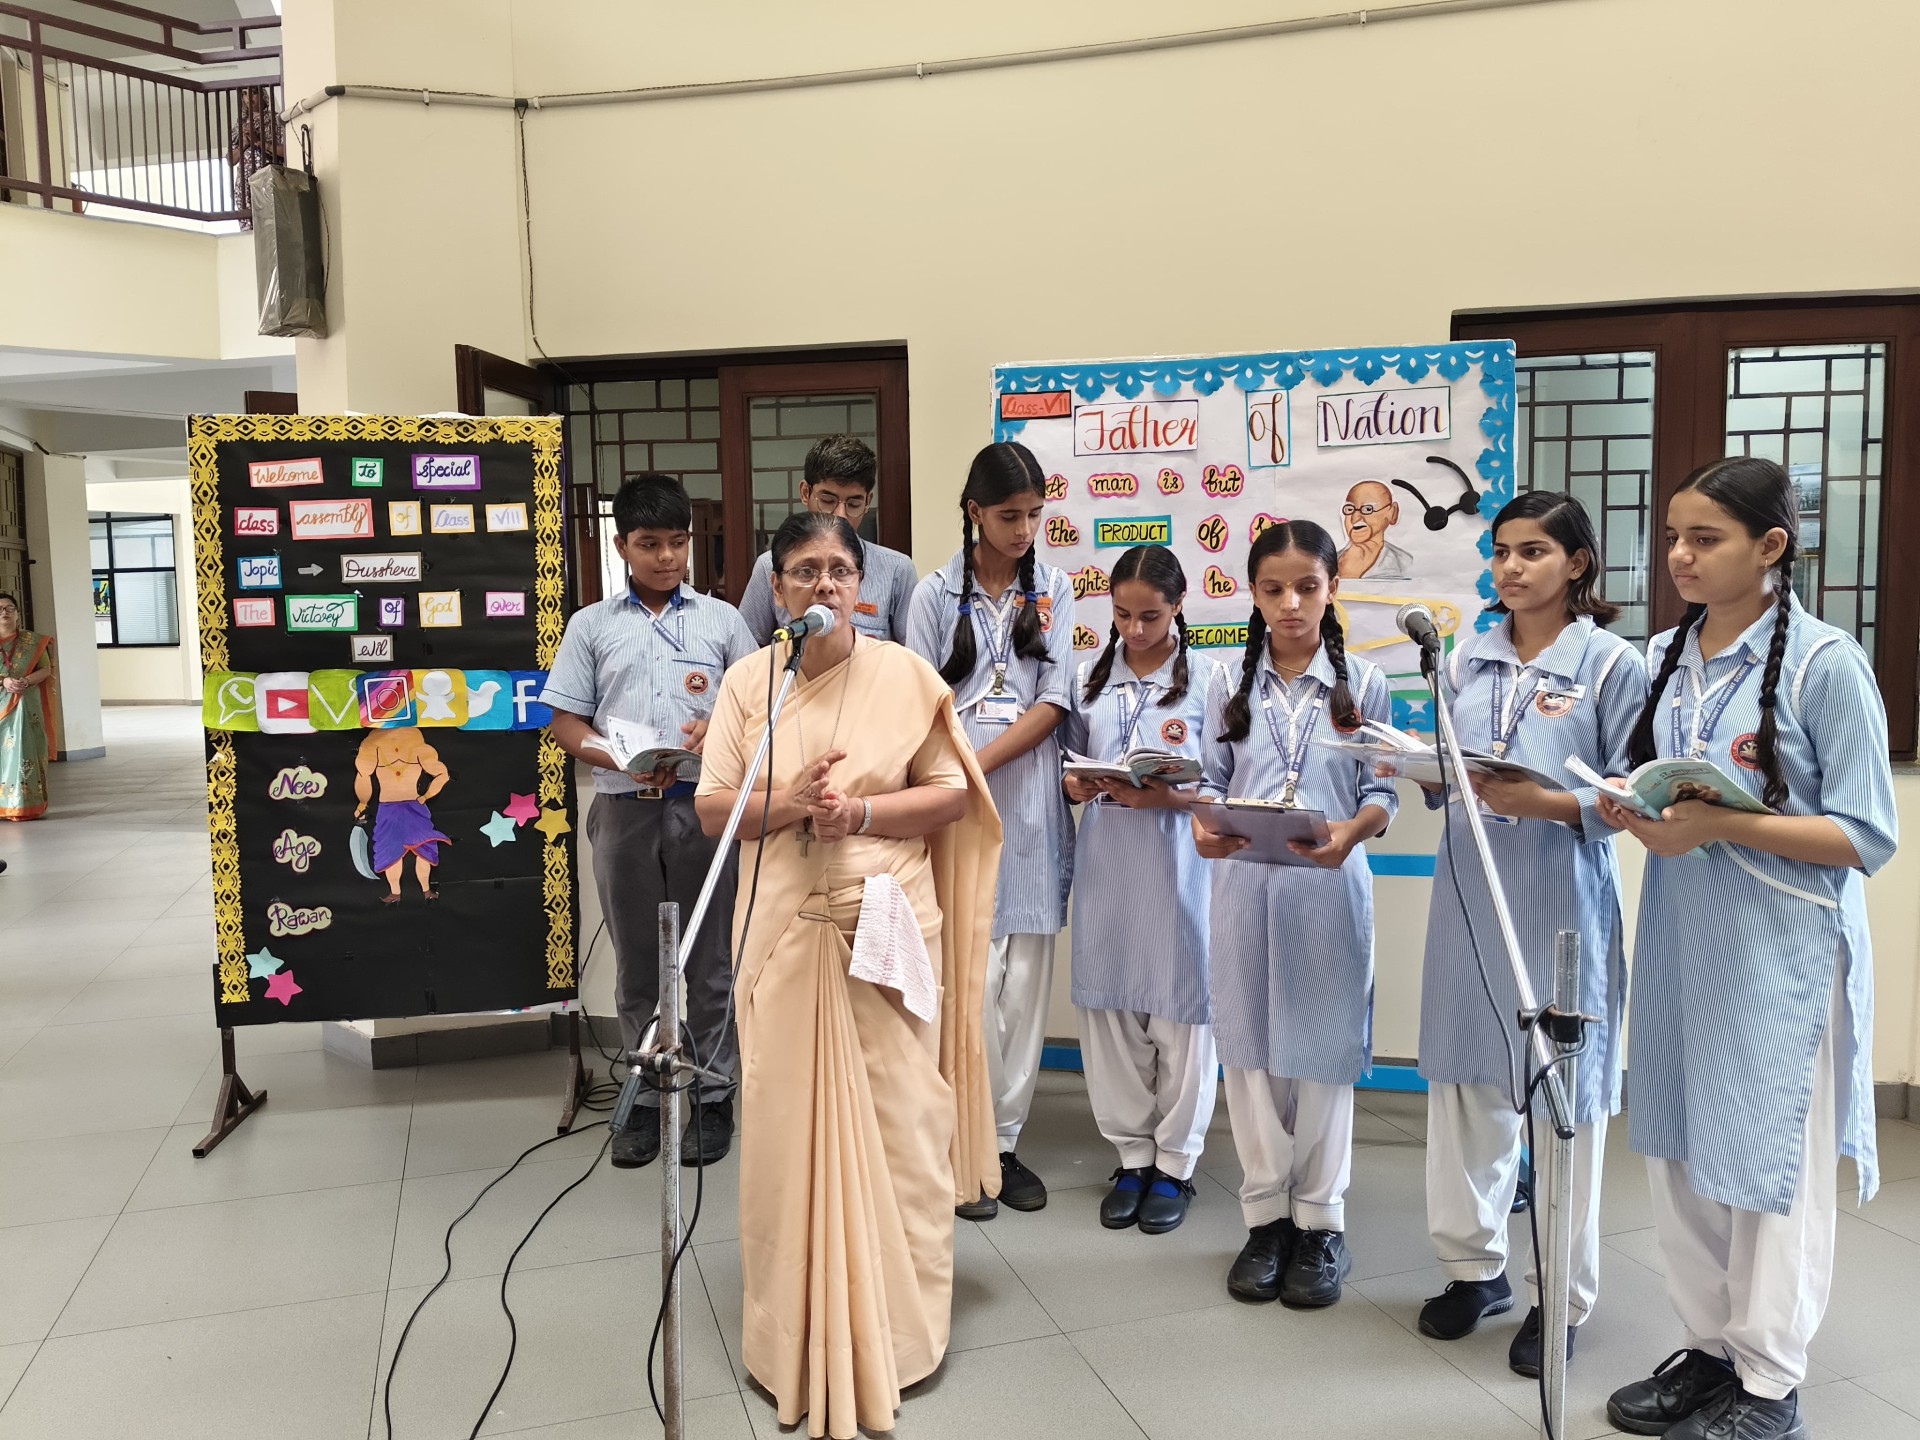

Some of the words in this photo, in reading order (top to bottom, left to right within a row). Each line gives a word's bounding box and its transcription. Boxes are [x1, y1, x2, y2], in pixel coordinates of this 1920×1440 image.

[1078, 405, 1198, 450] Father
[1317, 392, 1447, 442] Nation
[254, 466, 318, 484] Welcome
[358, 463, 376, 478] to
[1093, 478, 1133, 492] man
[1162, 471, 1178, 489] is
[1205, 468, 1240, 492] but
[297, 503, 368, 533] assembly
[396, 505, 412, 529] of
[495, 507, 520, 525] VIII
[1049, 519, 1077, 542] the
[1099, 523, 1167, 541] PRODUCT
[241, 559, 278, 585] Topic
[345, 558, 417, 579] Dusshera
[1209, 570, 1232, 594] he
[239, 604, 268, 621] The
[425, 596, 453, 624] God
[490, 597, 521, 612] over
[1719, 681, 1736, 704] CONVENT
[1733, 662, 1749, 683] SCHOOL
[271, 771, 320, 797] New
[274, 832, 317, 869] Age
[271, 905, 330, 931] Rawan
